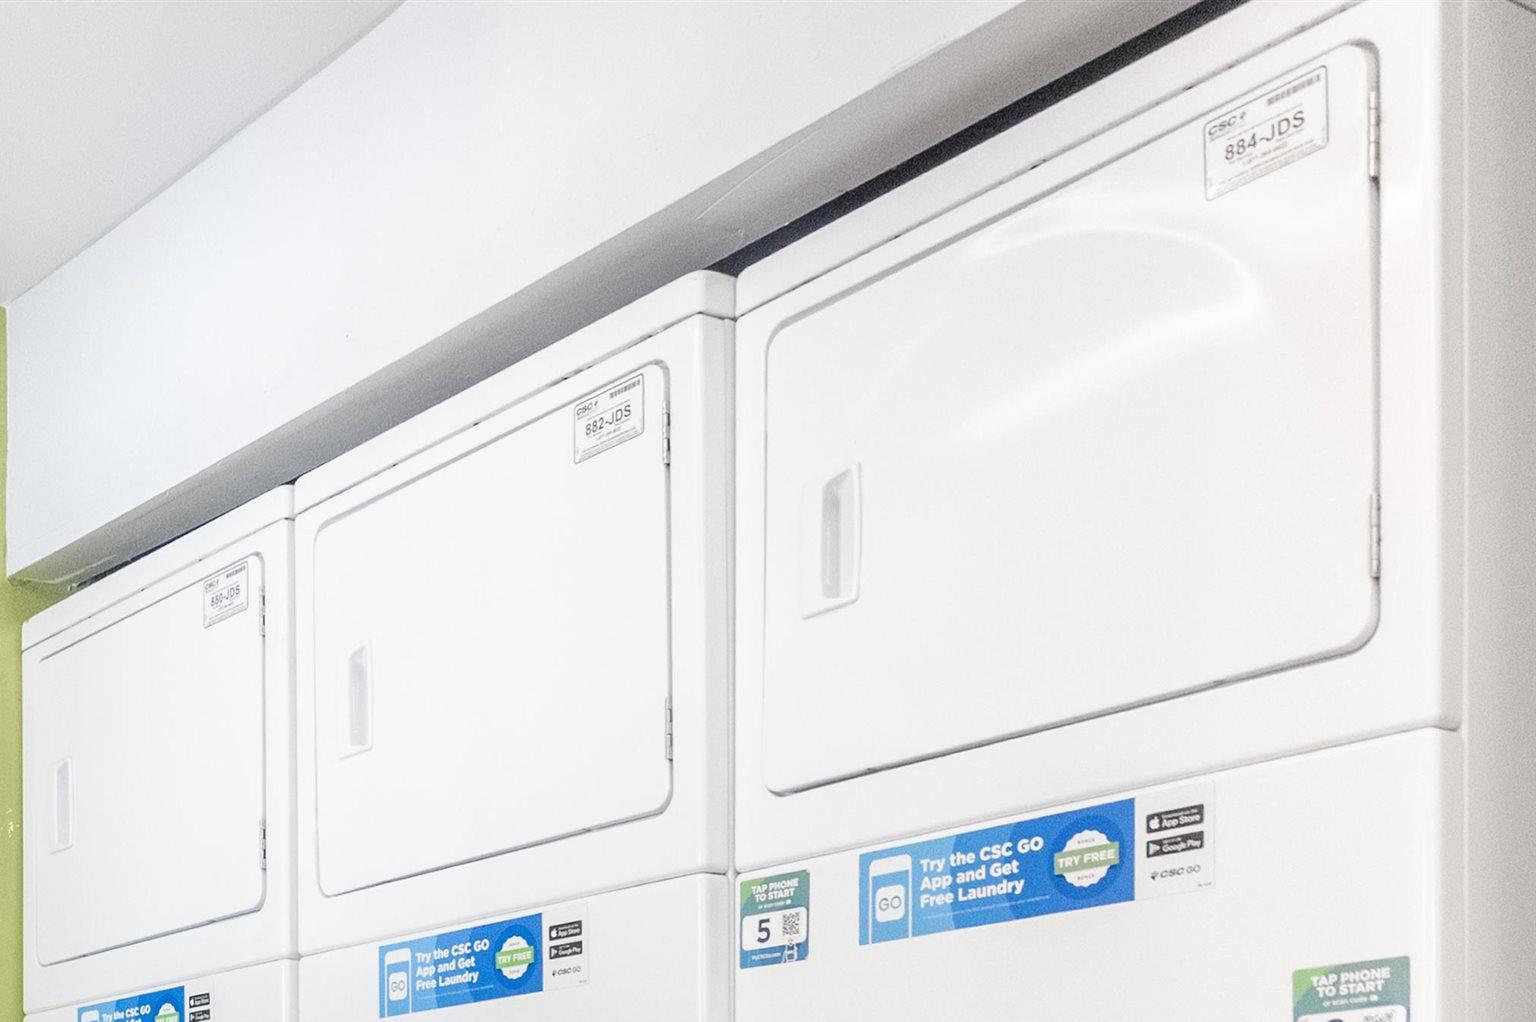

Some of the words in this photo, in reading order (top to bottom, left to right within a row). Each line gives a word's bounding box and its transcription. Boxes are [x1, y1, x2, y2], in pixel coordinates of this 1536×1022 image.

[1225, 110, 1305, 161] 884-JDS
[585, 404, 631, 436] 882-JDS
[1162, 818, 1179, 828] App
[920, 857, 946, 874] Try
[949, 850, 976, 867] the
[979, 842, 1013, 861] CSC
[1016, 836, 1045, 855] GO
[1056, 856, 1082, 869] TRY
[1083, 848, 1117, 865] FREE
[920, 873, 953, 892] App
[956, 864, 987, 884] and
[989, 859, 1020, 878] Get
[1160, 867, 1184, 878] CSC
[1186, 864, 1201, 874] GO
[752, 885, 768, 895] TAP
[769, 878, 799, 890] PHONE
[755, 894, 767, 903] TO
[768, 887, 796, 900] START
[920, 892, 954, 908] Free
[957, 878, 1025, 902] Laundry
[878, 895, 902, 912] GO
[757, 918, 771, 943] 5
[415, 952, 431, 964] Try
[433, 946, 450, 959] the
[451, 941, 472, 956] CSC
[473, 938, 490, 952] GO
[497, 955, 512, 964] TRY
[512, 951, 531, 961] FREE
[415, 965, 436, 979] App
[437, 959, 457, 973] and
[457, 956, 476, 969] Get
[1310, 973, 1338, 986] TAP
[1340, 967, 1391, 982] PHONE
[391, 980, 406, 992] GO
[416, 979, 437, 991] Free
[438, 969, 479, 988] Laundry
[1316, 986, 1336, 998] TO
[1339, 979, 1385, 996] START
[102, 1013, 113, 1022] Try
[114, 1009, 125, 1020] the
[125, 1006, 139, 1019] CSC
[140, 1004, 151, 1016] GO
